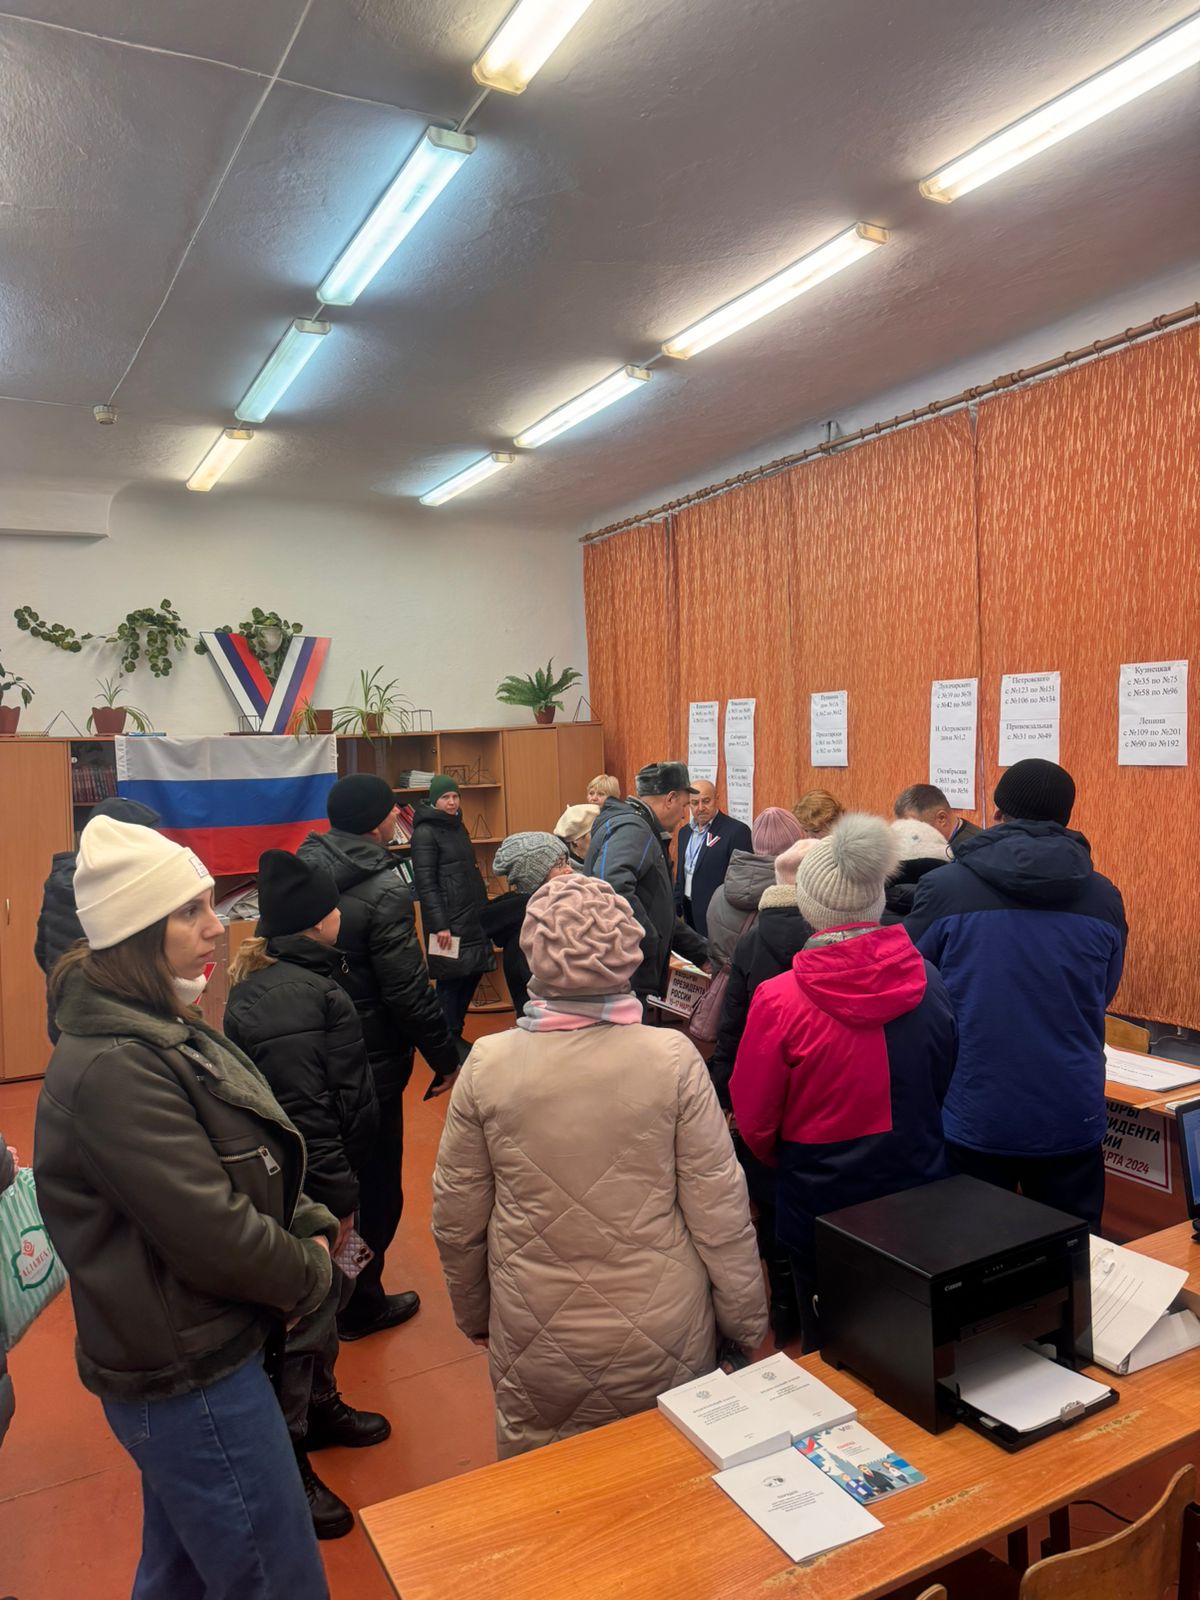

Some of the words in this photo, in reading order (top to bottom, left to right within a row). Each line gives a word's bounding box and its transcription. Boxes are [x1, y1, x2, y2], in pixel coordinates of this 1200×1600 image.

[1135, 666, 1171, 675] Кузнецкая
[1139, 717, 1165, 725] Ленина
[1106, 1116, 1160, 1144] ИДЕНТА
[1125, 1158, 1150, 1174] 2024
